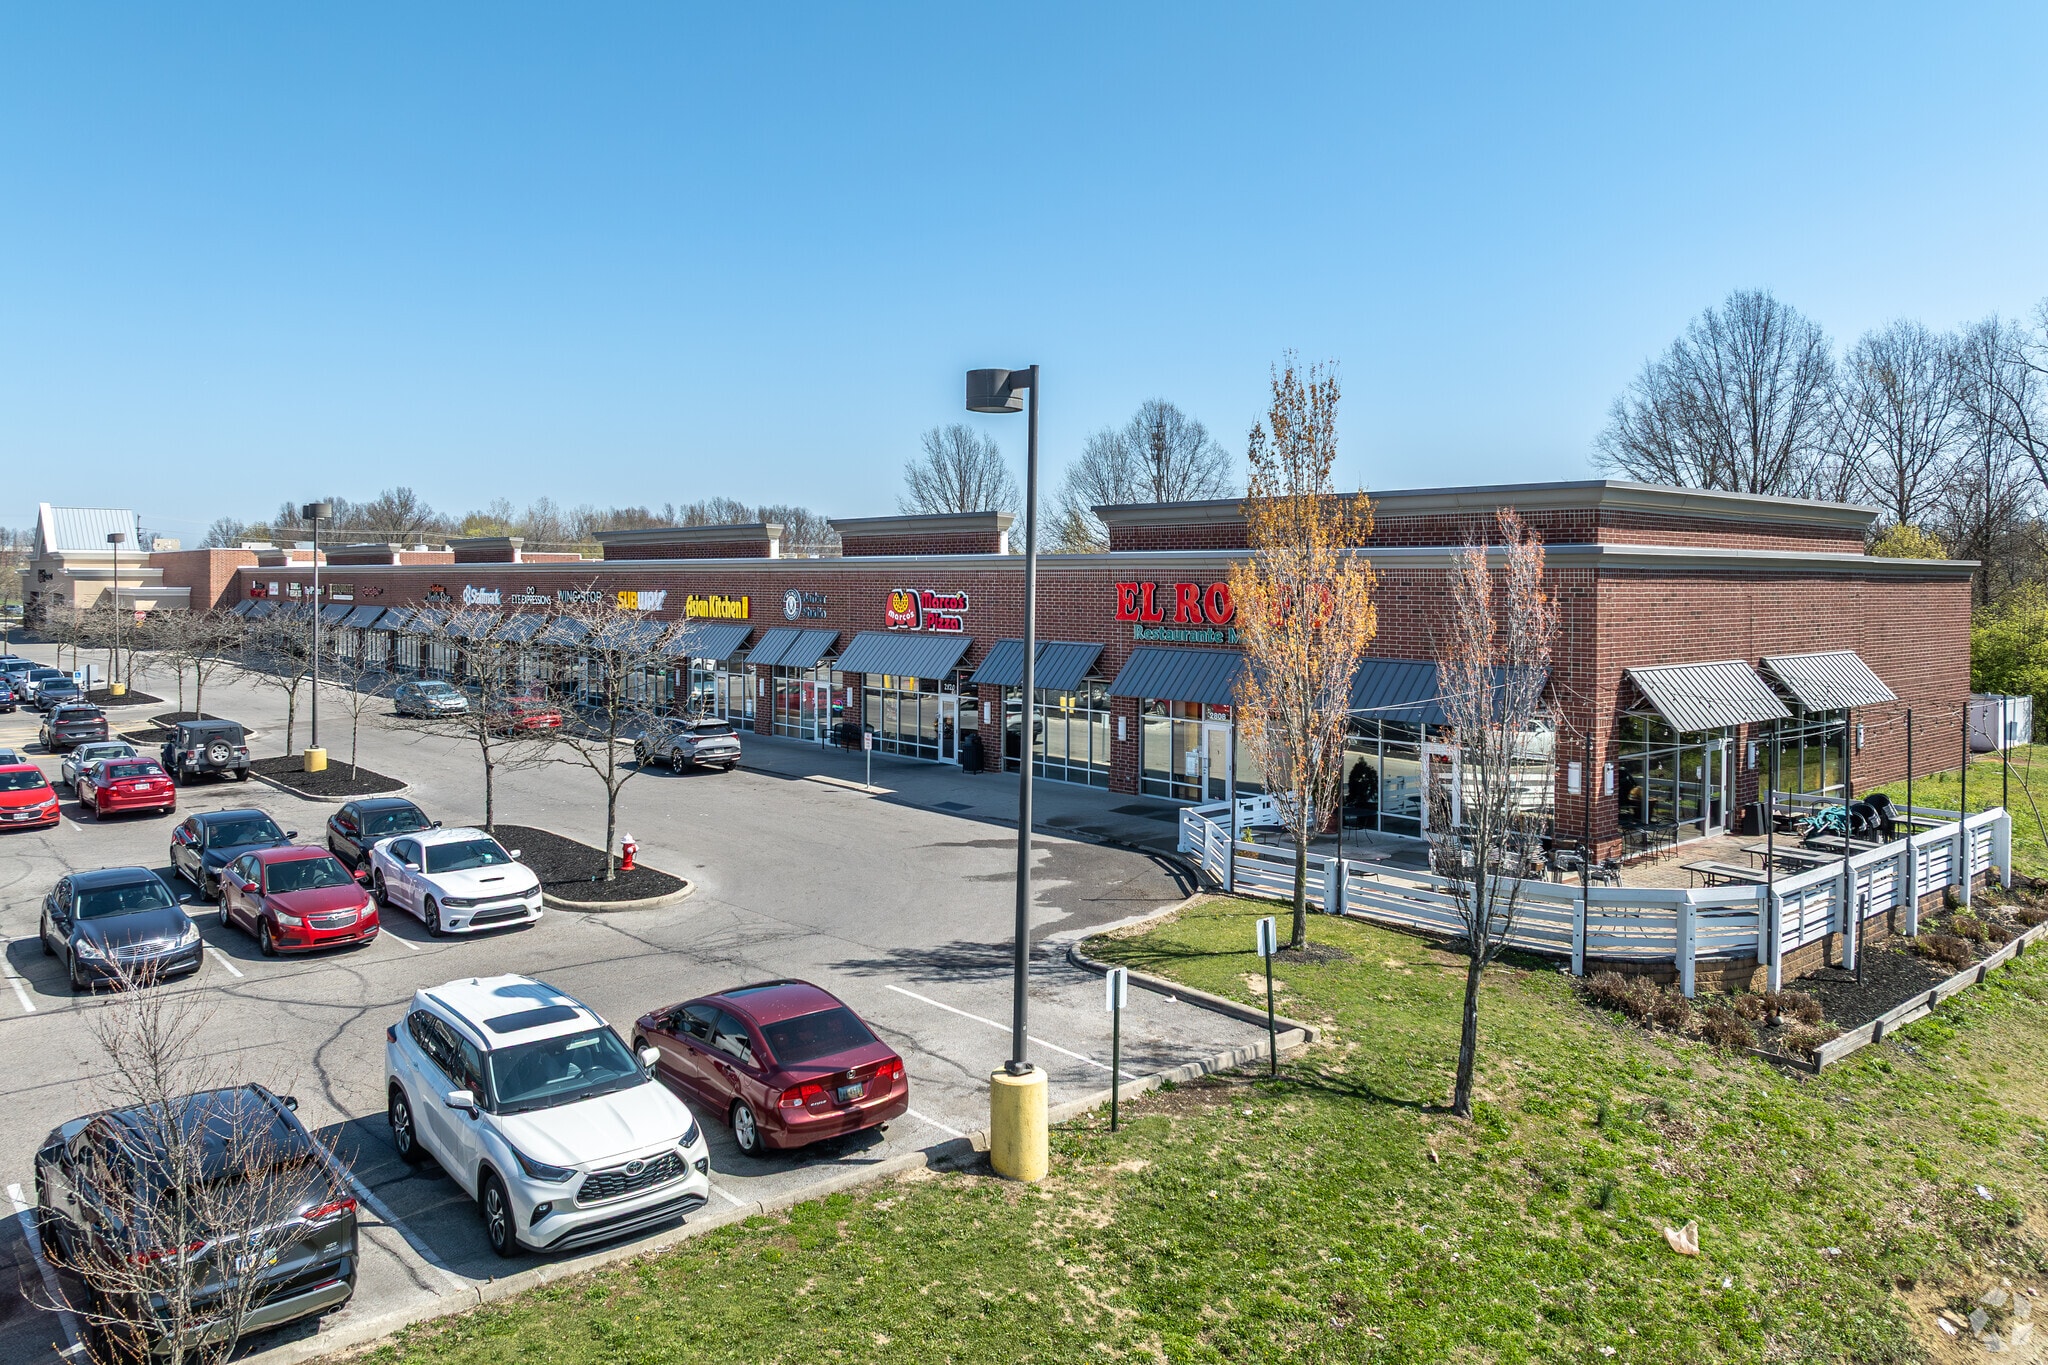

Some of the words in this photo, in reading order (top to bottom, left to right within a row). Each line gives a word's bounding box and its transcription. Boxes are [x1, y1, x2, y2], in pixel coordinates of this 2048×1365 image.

[471, 587, 501, 605] Staffmark
[511, 594, 520, 604] EYE
[521, 595, 551, 605] EXPRESSIONS
[617, 589, 667, 611] SUBWAY
[921, 592, 965, 609] Marco's
[1114, 582, 1163, 622] EL
[686, 594, 709, 618] Asian
[709, 595, 742, 618] Kitchen
[927, 613, 959, 630] Pizza
[1133, 624, 1224, 643] Restaurante
